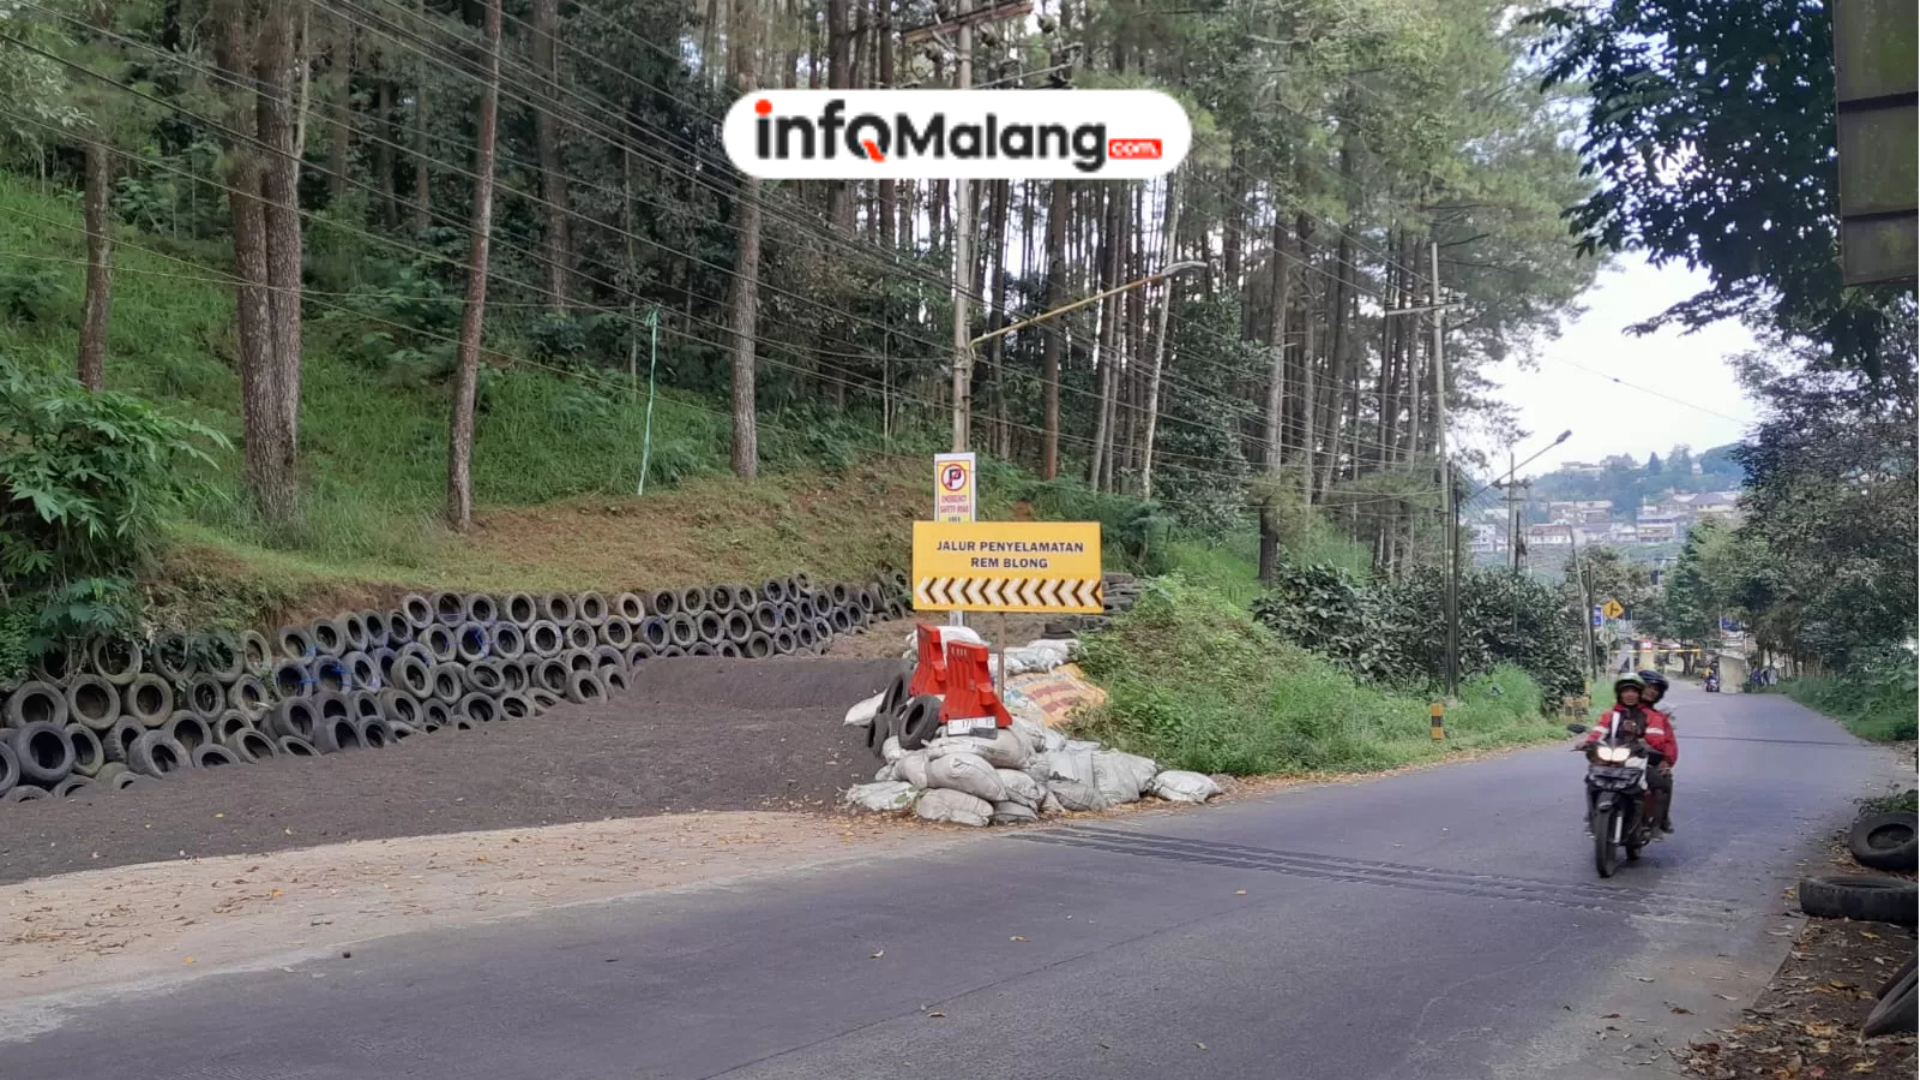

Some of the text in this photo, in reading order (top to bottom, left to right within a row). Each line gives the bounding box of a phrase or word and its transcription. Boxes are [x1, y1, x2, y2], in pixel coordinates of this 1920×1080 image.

[936, 541, 1084, 552] JALUR PENYELAMATAN
[971, 557, 1048, 569] REM BLONG
